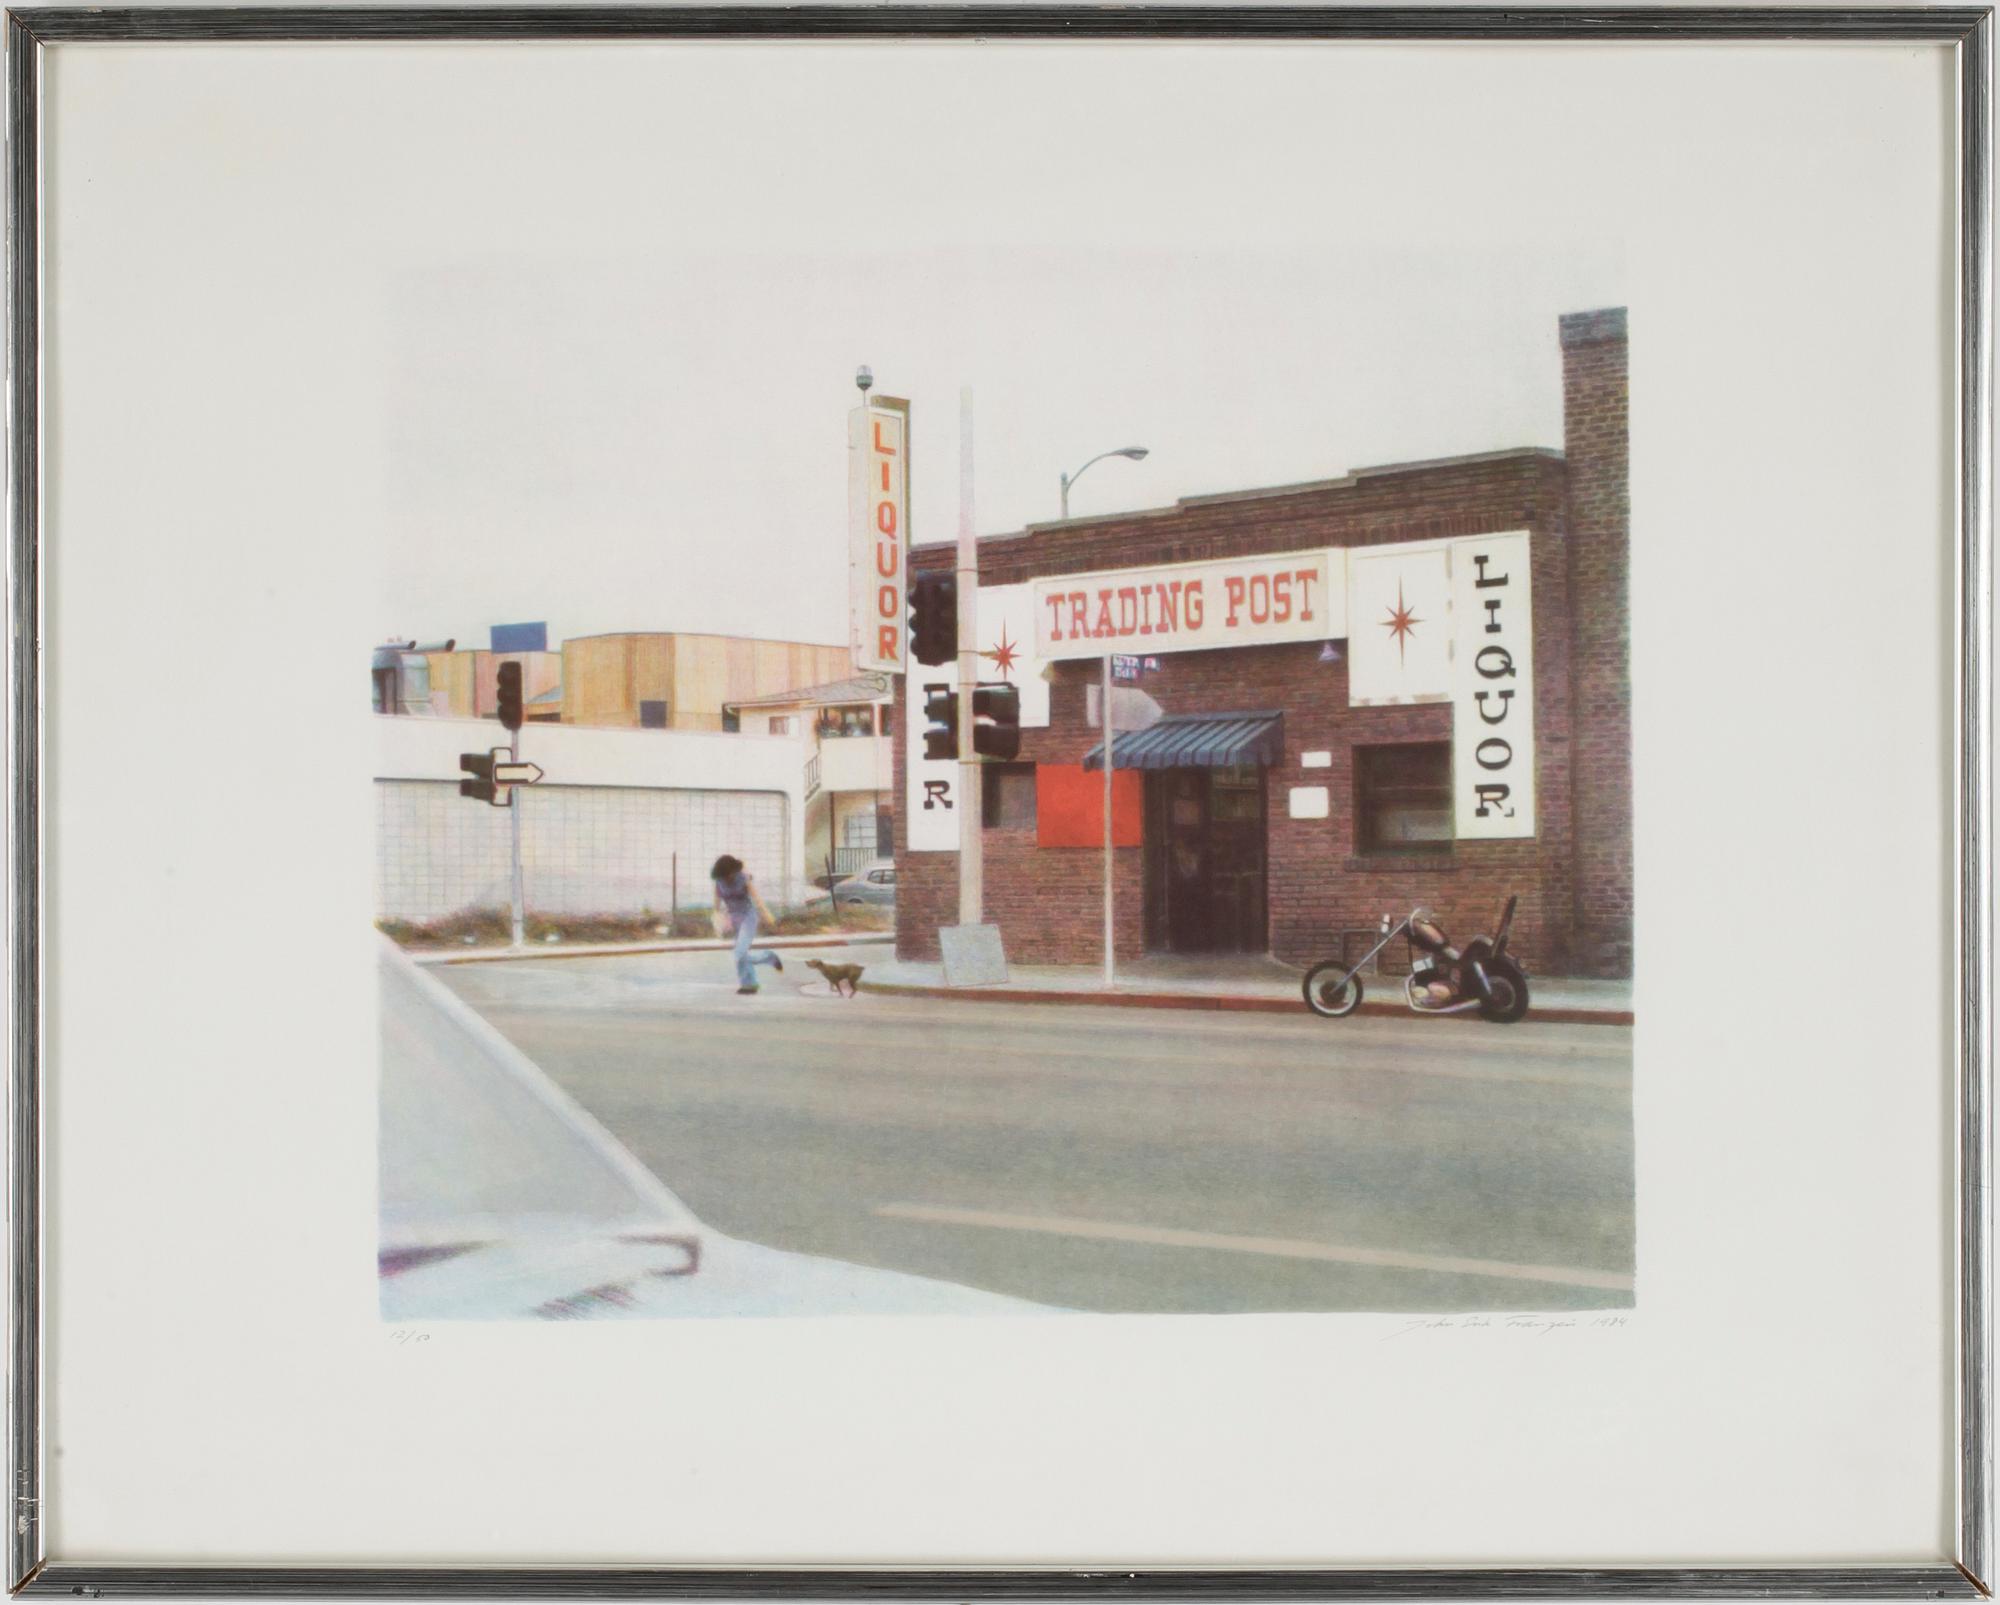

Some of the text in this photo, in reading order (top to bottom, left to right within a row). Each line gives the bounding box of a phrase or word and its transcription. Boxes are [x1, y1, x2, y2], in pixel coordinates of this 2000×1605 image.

[874, 421, 899, 661] LIQUOR
[1046, 568, 1318, 641] TRADING POST
[1473, 554, 1517, 819] LIQUOR
